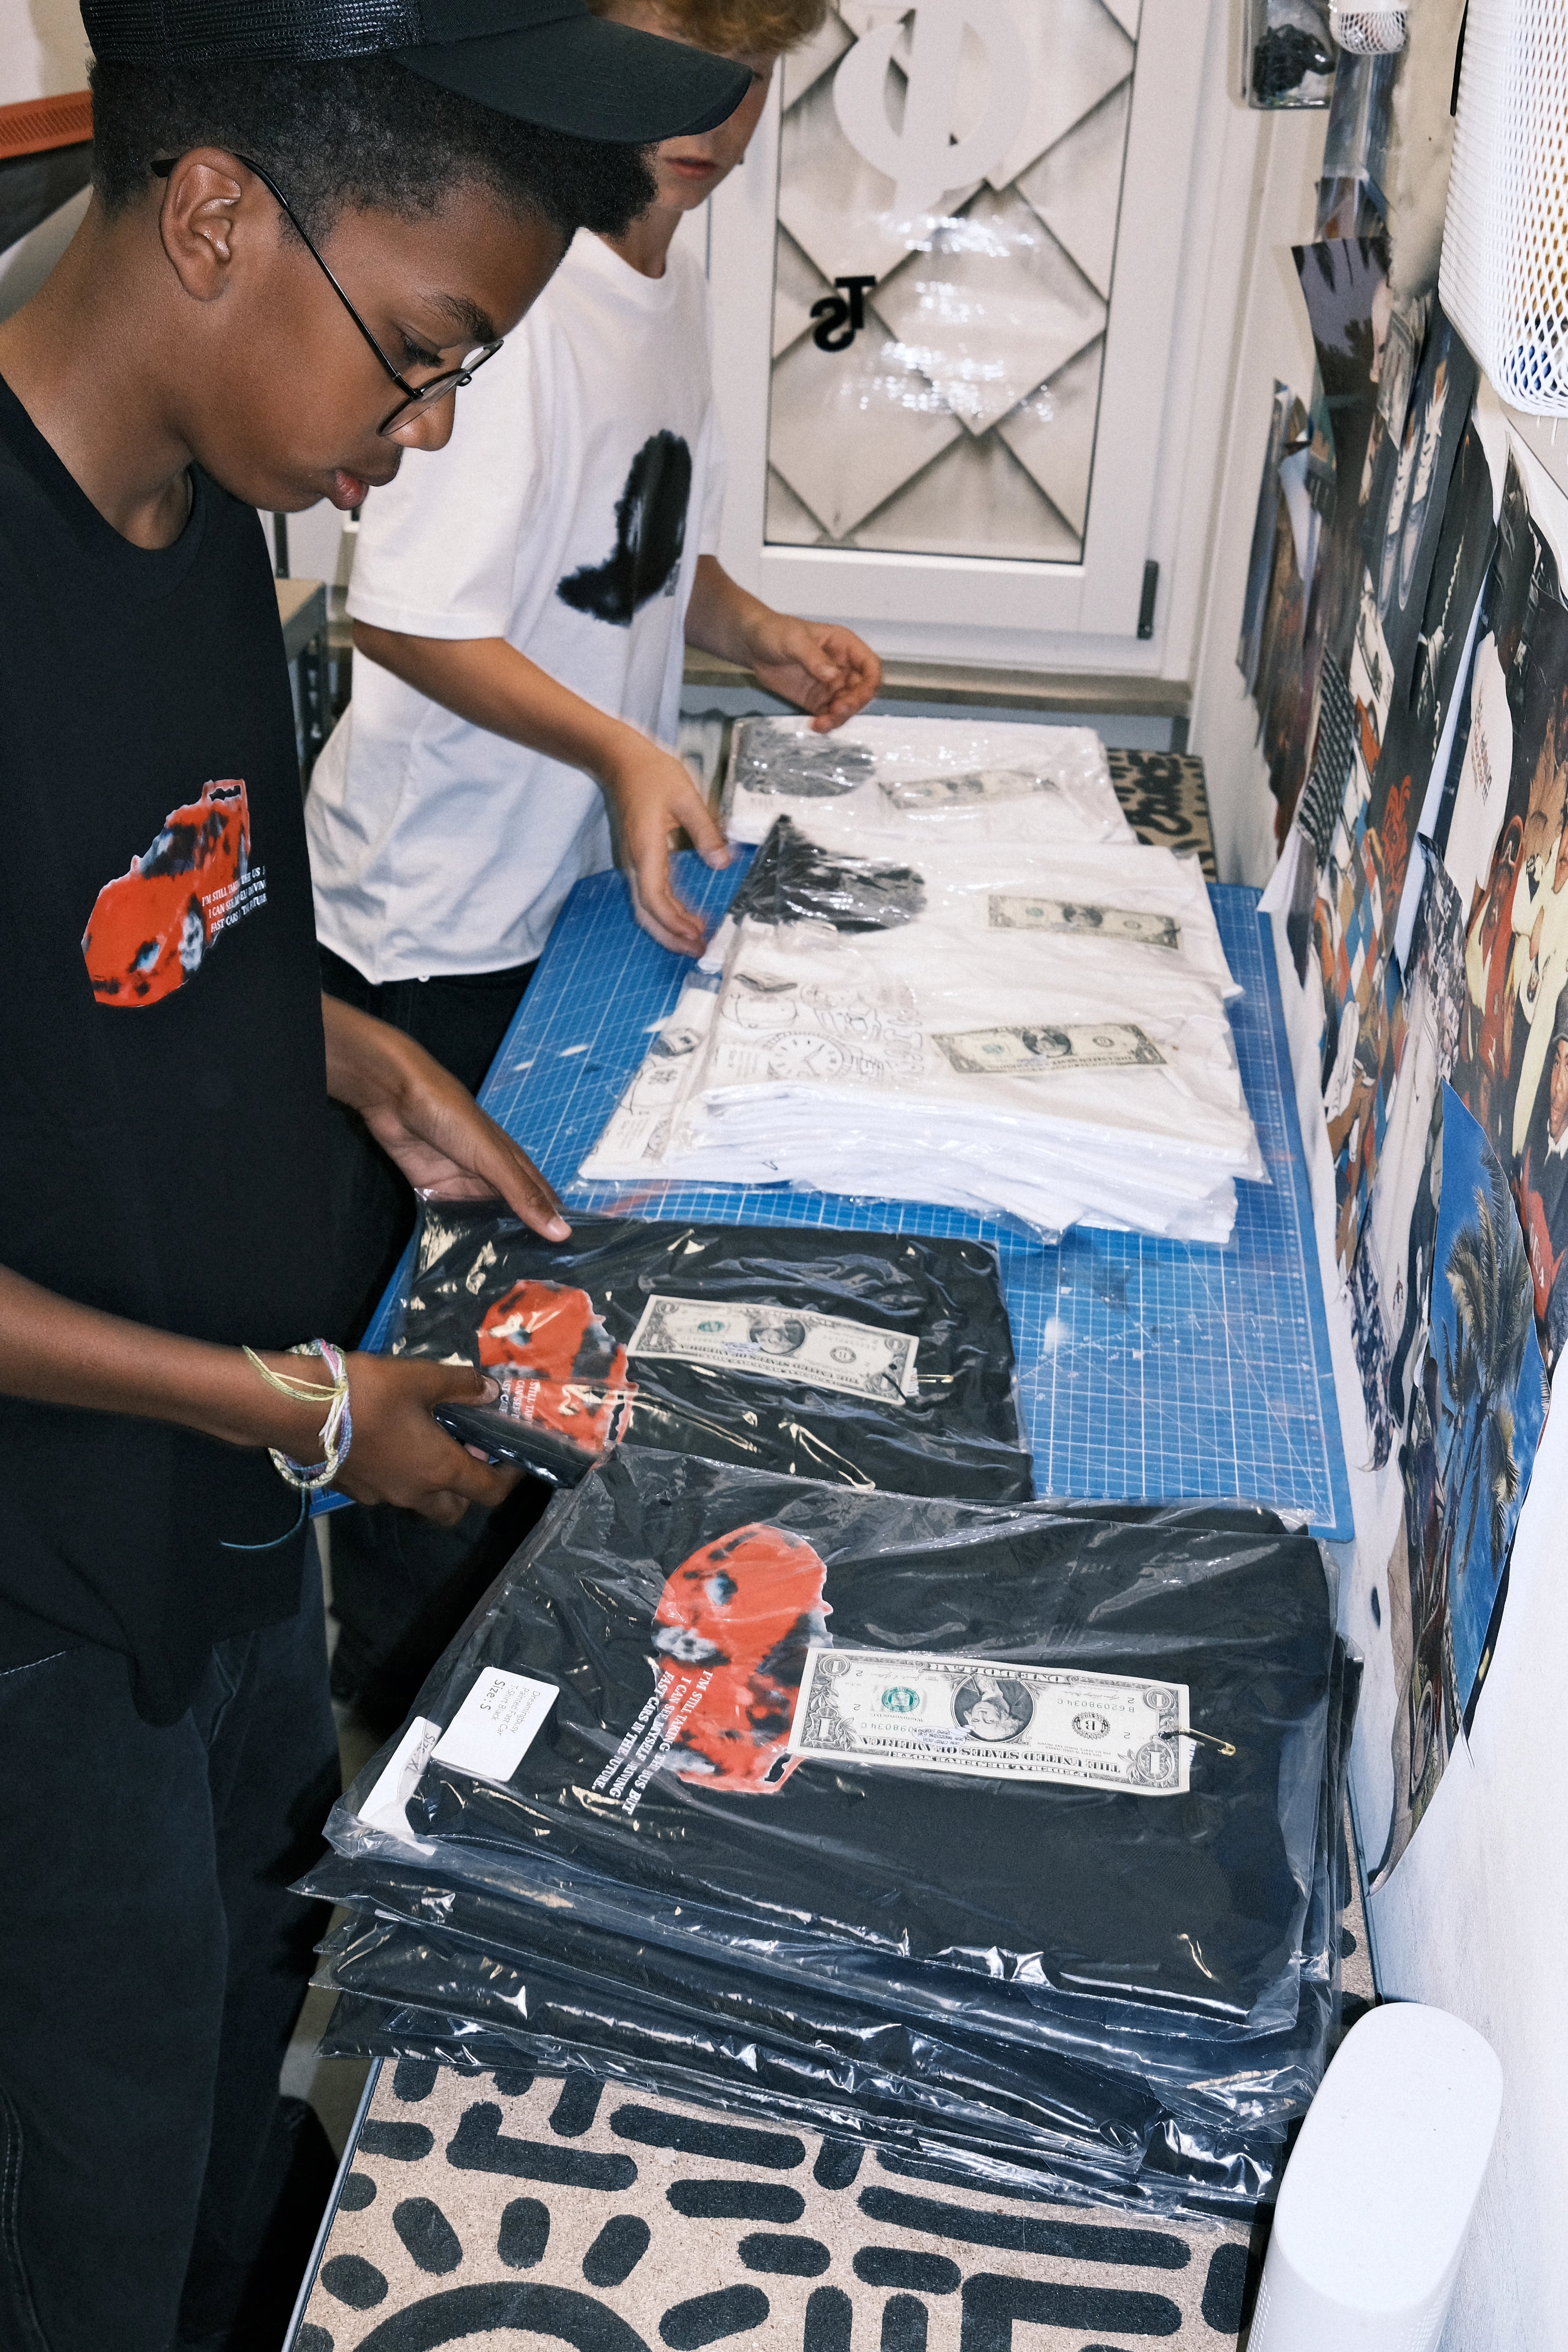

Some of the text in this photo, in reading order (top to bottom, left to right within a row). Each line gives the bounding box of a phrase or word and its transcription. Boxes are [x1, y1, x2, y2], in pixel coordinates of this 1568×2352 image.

[202, 893, 211, 906] I'M
[212, 887, 227, 901] STILL
[209, 909, 212, 919] I
[212, 903, 225, 916] CAN
[211, 918, 225, 933] FAST
[225, 911, 238, 926] CARS
[501, 1380, 511, 1393] AST
[514, 1380, 525, 1397] CAN
[929, 1663, 1010, 1677] DOLLAR
[1014, 1670, 1065, 1683] ONE
[654, 1670, 675, 1699] FAST
[490, 1684, 519, 1721] T-Shirt Black
[668, 1684, 687, 1704] CAN
[497, 1687, 530, 1736] Painted Fast Car
[510, 1690, 541, 1734] Dreamingbusy
[638, 1696, 659, 1724] CARS
[657, 1704, 675, 1720] SEE
[631, 1721, 645, 1735] IN
[818, 1717, 832, 1738] 1
[1085, 1720, 1096, 1731] B
[617, 1732, 638, 1757] THE
[621, 1670, 713, 1815] I'M STILL TAKING THE BUS BUT
[635, 1722, 665, 1762] MYSELF
[858, 1735, 933, 1752] AMERICA
[933, 1745, 958, 1754] OF
[960, 1746, 1019, 1760] STATES
[1022, 1751, 1082, 1767] UNITED
[404, 1757, 418, 1773] XL
[1086, 1758, 1120, 1773] THE
[1148, 1750, 1163, 1774] 1
